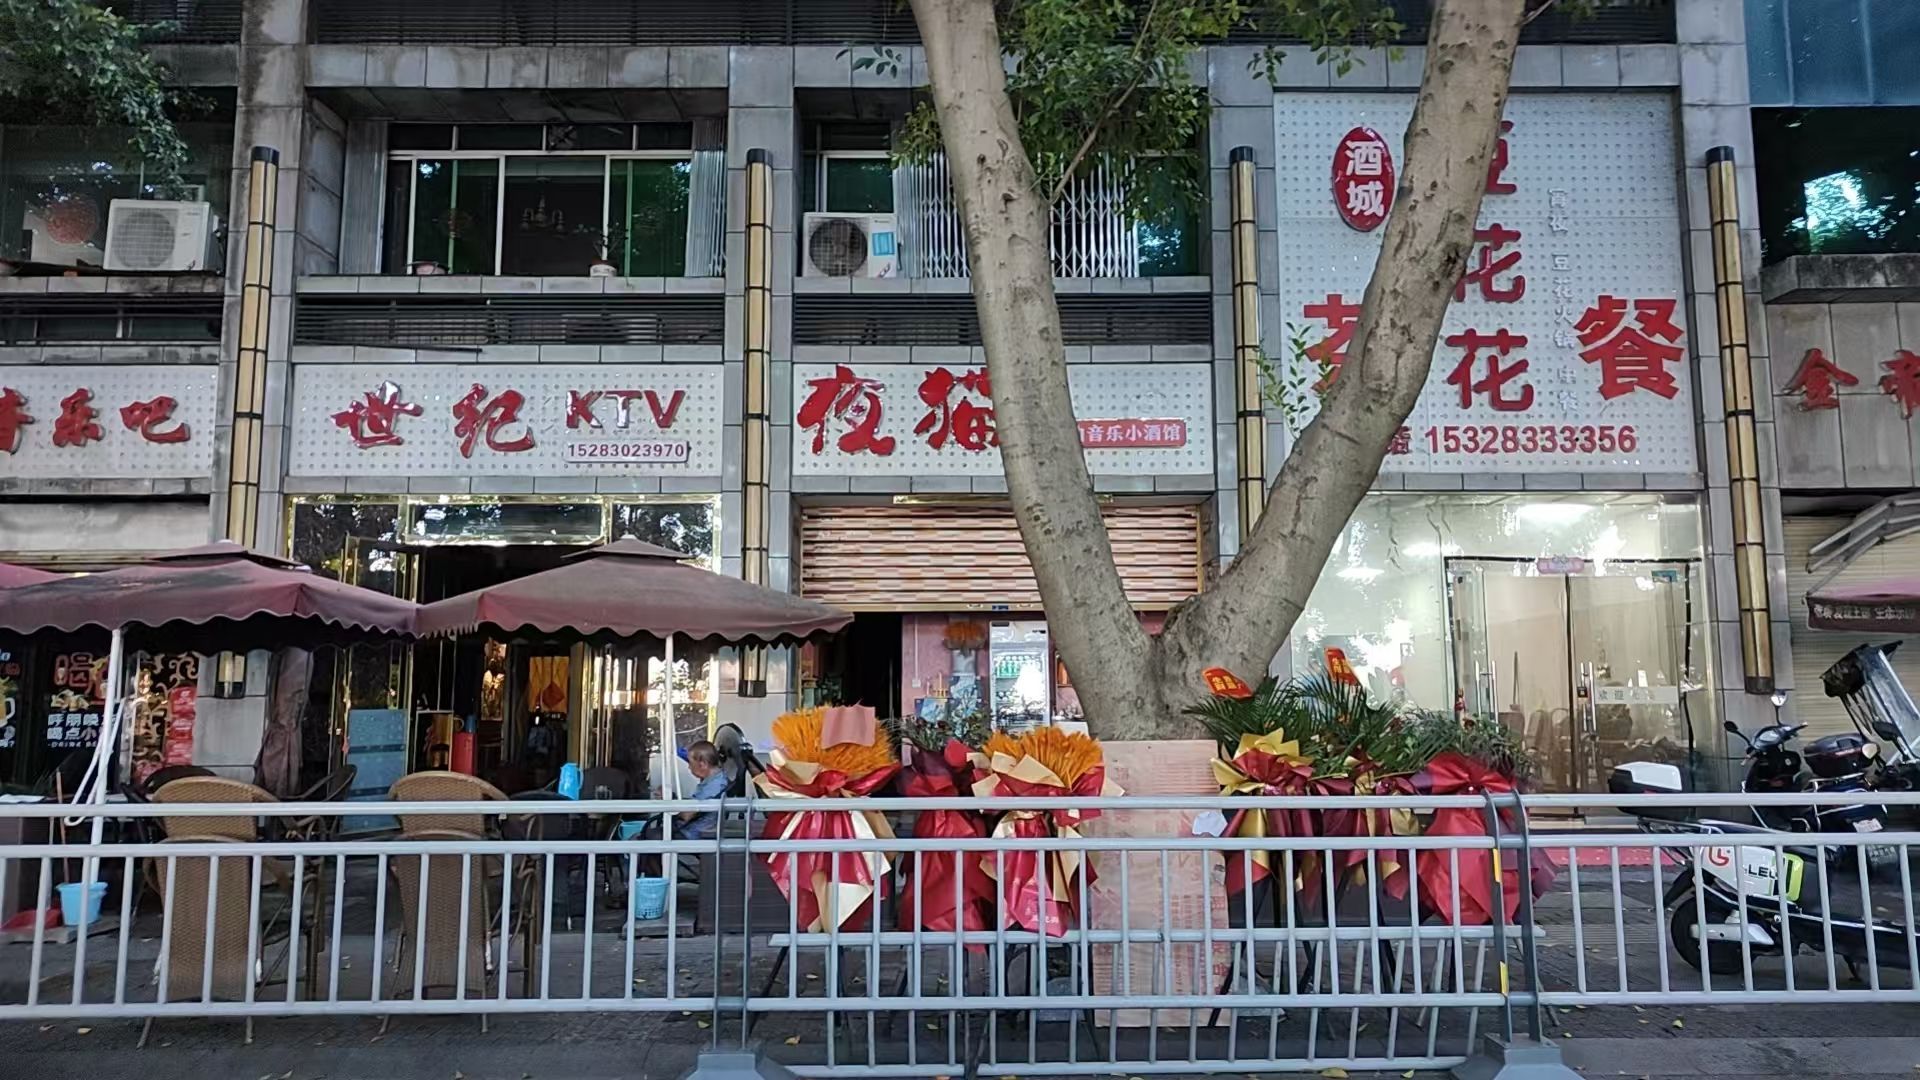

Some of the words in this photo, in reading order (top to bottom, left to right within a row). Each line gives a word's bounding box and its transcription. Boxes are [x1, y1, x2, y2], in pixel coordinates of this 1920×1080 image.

[1345, 140, 1385, 218] 酒城
[1574, 294, 1685, 401] 餐
[331, 380, 535, 458] 世纪
[566, 390, 686, 429] KTV
[1078, 424, 1181, 442] 音乐小酒馆
[1425, 425, 1637, 454] 15328333356
[568, 444, 685, 458] 15283023970
[48, 713, 117, 727] 呼朋唤
[47, 727, 103, 741] 喝点小
